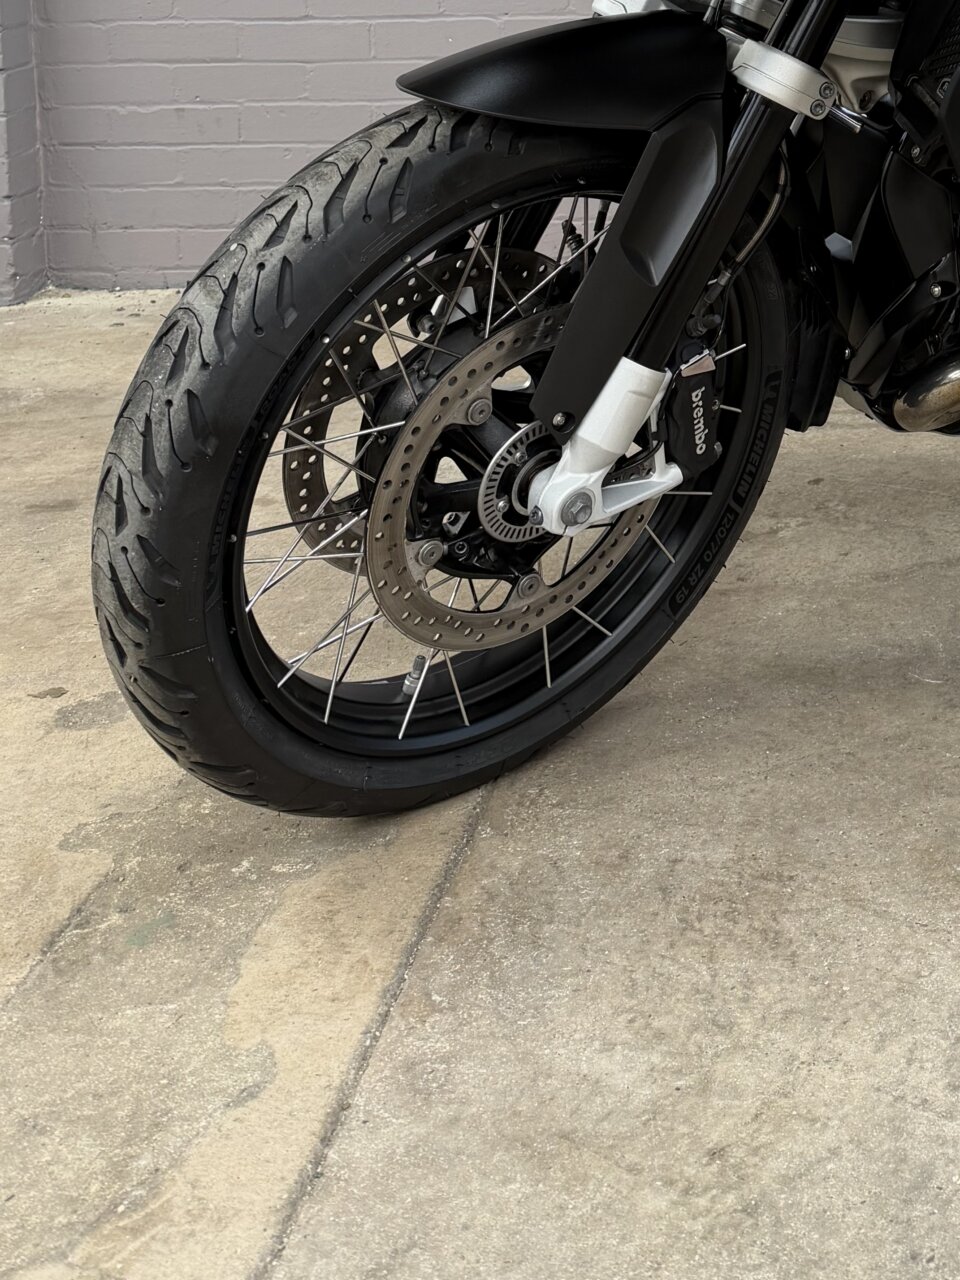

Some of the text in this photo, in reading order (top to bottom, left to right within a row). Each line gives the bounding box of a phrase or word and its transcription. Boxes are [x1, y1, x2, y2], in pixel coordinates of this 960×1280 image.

[691, 386, 707, 455] brembo
[737, 403, 775, 499] MICHELIN
[702, 511, 736, 563] 120/70
